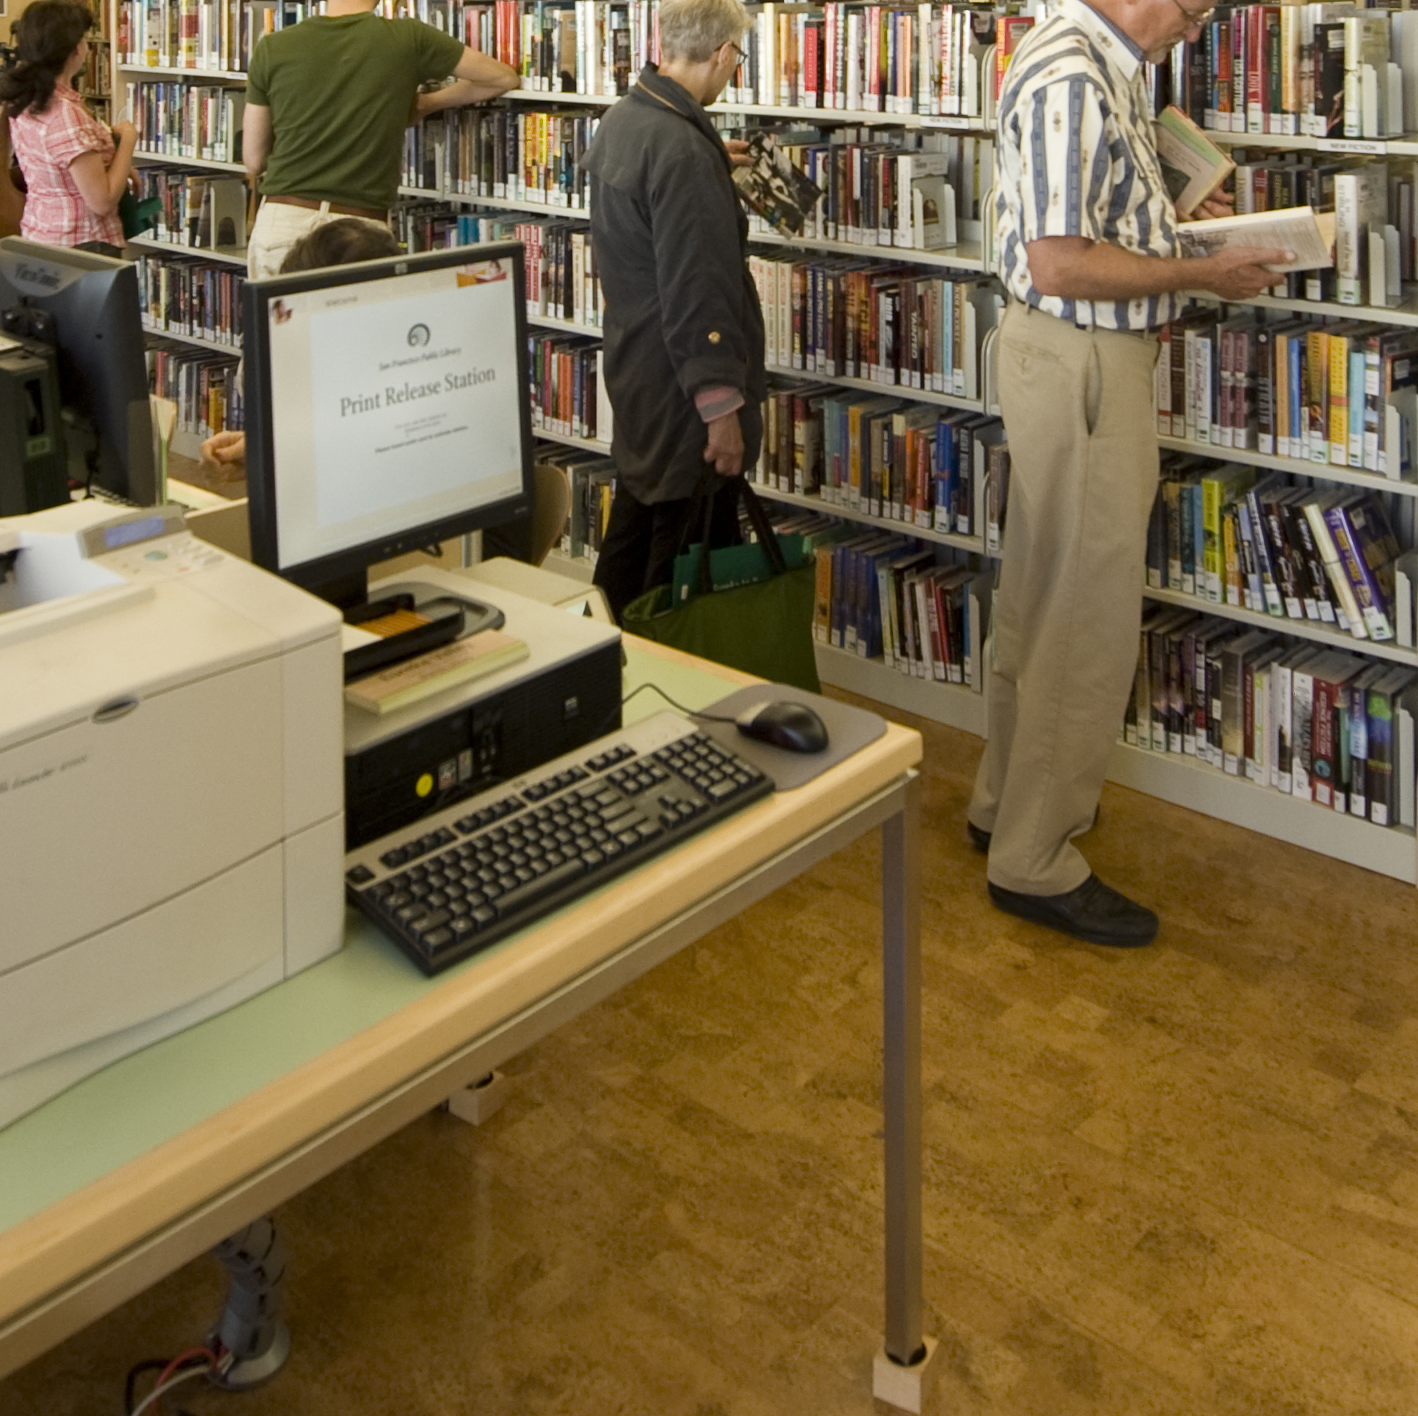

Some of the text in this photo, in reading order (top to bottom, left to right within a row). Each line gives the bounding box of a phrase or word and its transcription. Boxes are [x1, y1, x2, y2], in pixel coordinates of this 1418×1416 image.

[339, 366, 496, 418] Print Release Station
